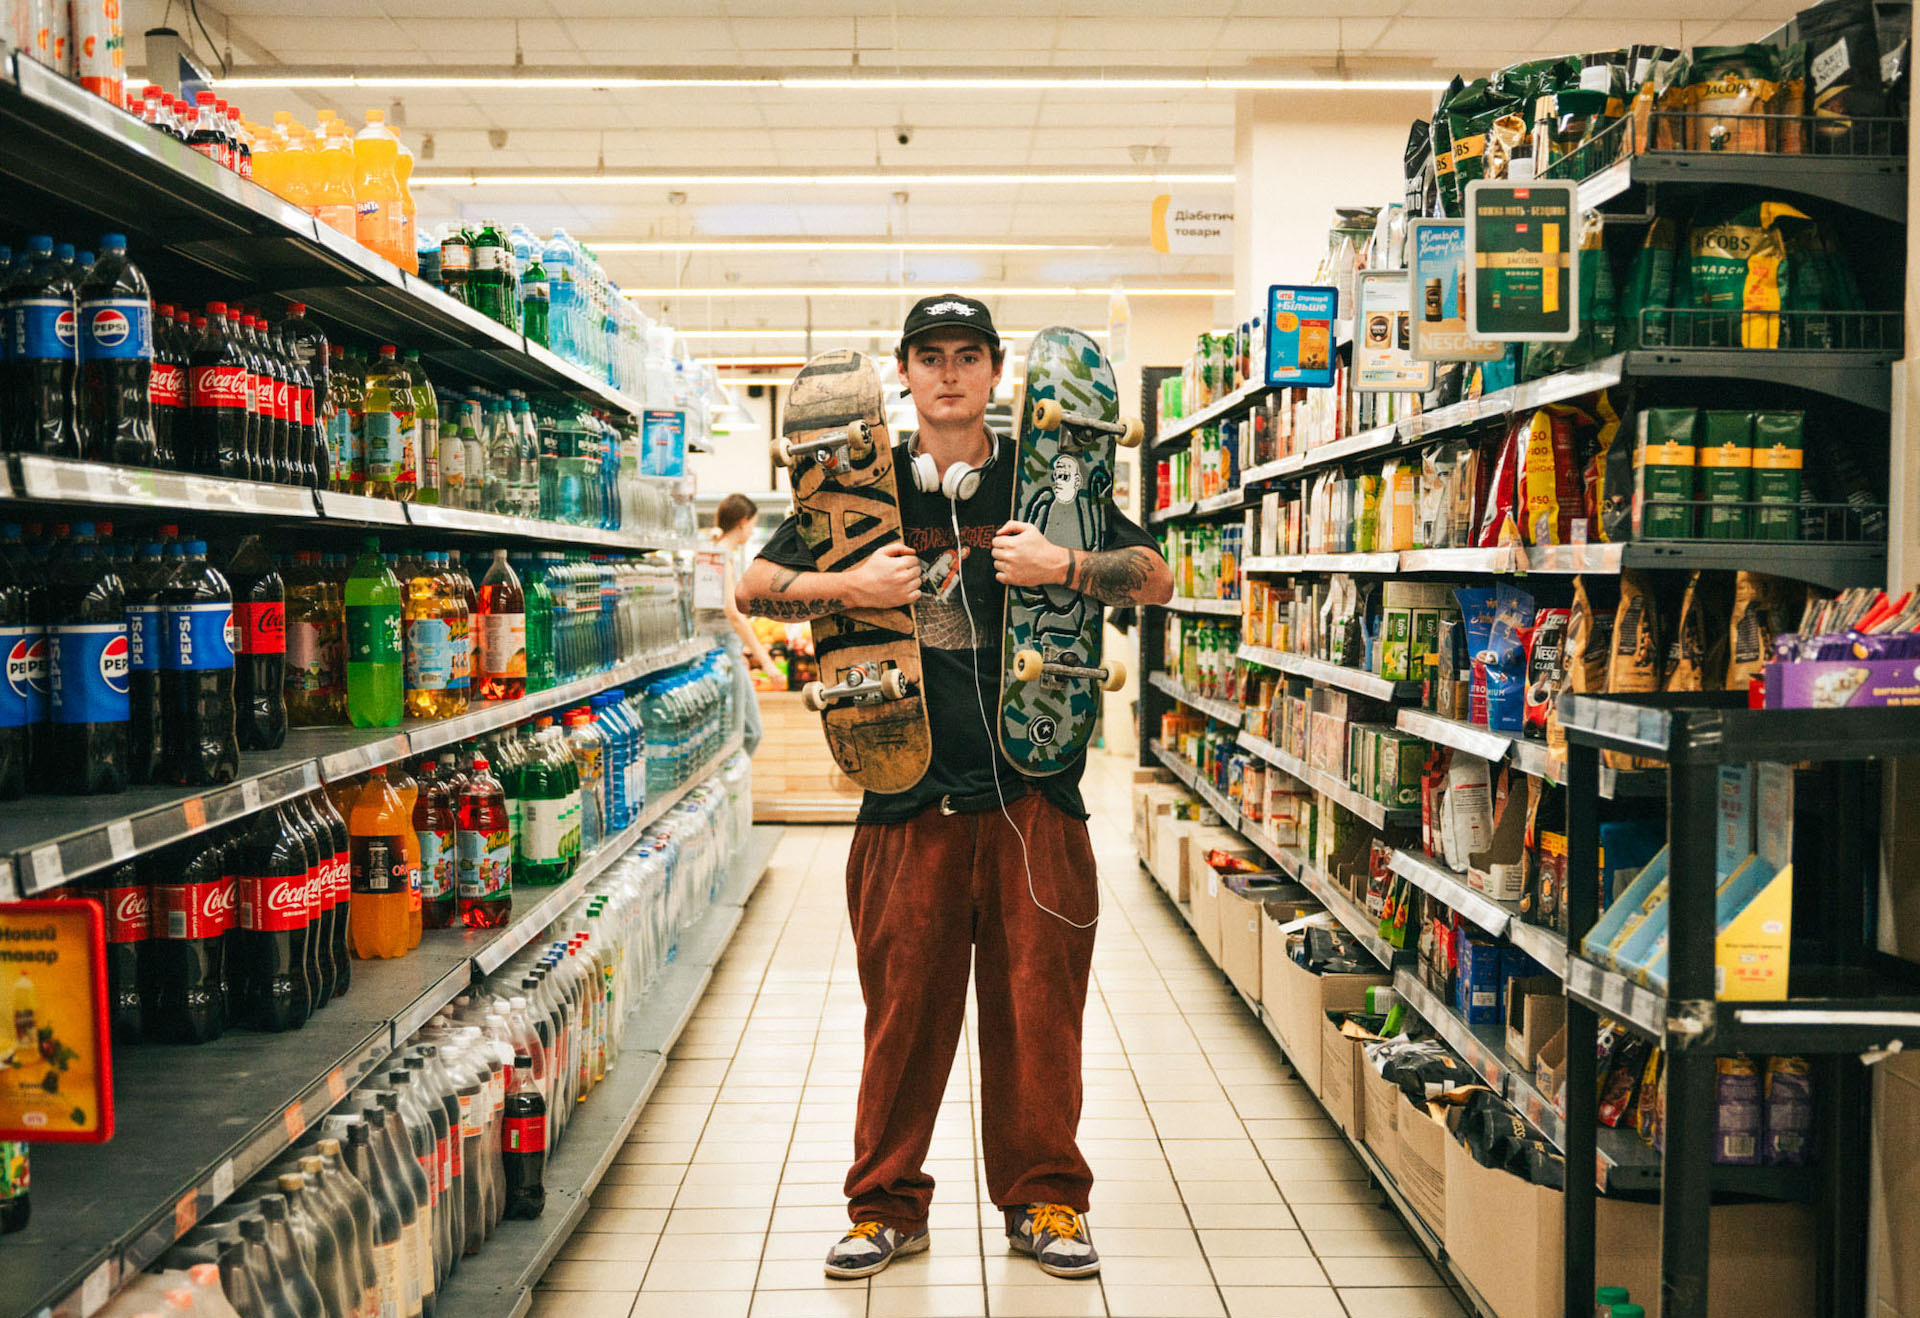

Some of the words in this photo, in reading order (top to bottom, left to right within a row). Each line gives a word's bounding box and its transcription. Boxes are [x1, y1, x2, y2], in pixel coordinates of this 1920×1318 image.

[1705, 83, 1752, 96] JACOBS
[357, 201, 380, 213] FANTA
[1174, 228, 1221, 238] товари
[58, 323, 75, 332] PEP
[94, 323, 127, 332] PEPSI
[132, 616, 143, 665] PEPSI
[179, 615, 193, 665] PEPSI
[104, 659, 128, 671] PEP
[50, 637, 63, 707] PEPSI
